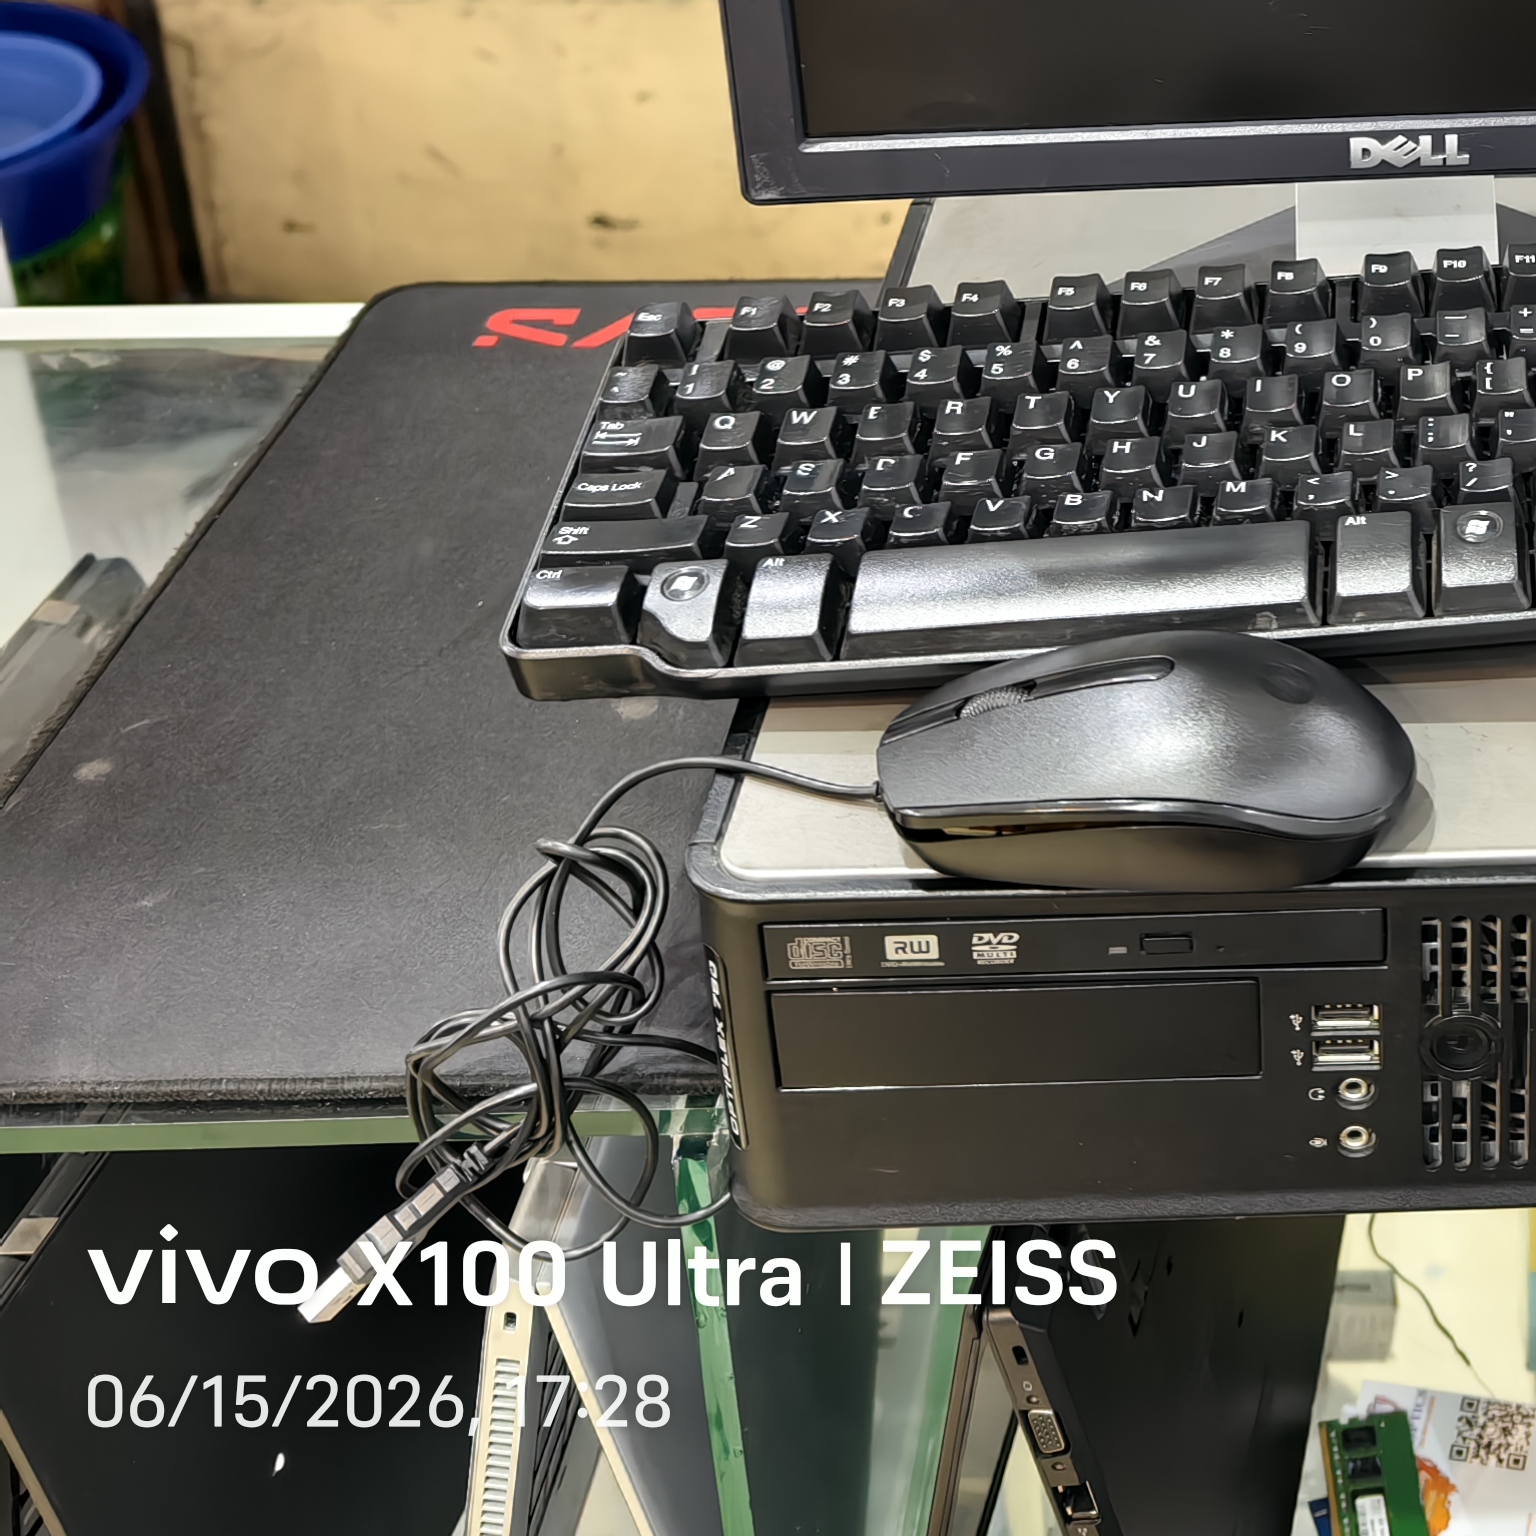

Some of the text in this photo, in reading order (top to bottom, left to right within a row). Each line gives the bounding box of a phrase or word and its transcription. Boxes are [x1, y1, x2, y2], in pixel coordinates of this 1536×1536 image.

[1348, 135, 1469, 167] DELL
[1442, 259, 1467, 269] F10
[1514, 254, 1536, 264] F11
[1371, 264, 1388, 274] F9
[1204, 276, 1223, 286] F7
[1276, 271, 1295, 281] F8
[1057, 287, 1075, 296] F5
[1130, 282, 1148, 292] F6
[888, 298, 906, 308] F3
[961, 293, 979, 303] F4
[740, 306, 758, 316] F1
[813, 302, 832, 313] F2
[636, 312, 663, 322] Esc
[1218, 347, 1232, 359] 8
[1294, 342, 1307, 354] 9
[1066, 358, 1080, 370] 6
[1143, 353, 1157, 365] 7
[913, 368, 928, 380] 4
[990, 363, 1004, 375] 5
[1407, 368, 1424, 381] P
[759, 378, 776, 390] 2
[836, 373, 851, 386] 3
[1103, 390, 1121, 404] Y
[1177, 384, 1196, 398] U
[945, 400, 964, 415] R
[1024, 395, 1043, 410] T
[791, 410, 818, 425] W
[868, 406, 882, 420] E
[600, 421, 625, 430] Tab
[713, 415, 736, 430] Q
[1270, 429, 1288, 443] K
[1349, 423, 1364, 437] L
[1112, 441, 1132, 454] H
[1192, 435, 1207, 448] J
[954, 452, 974, 466] F
[1034, 447, 1055, 461] G
[576, 481, 643, 494] Caps Lock
[1225, 481, 1247, 493] M
[1064, 493, 1083, 506] B
[1142, 489, 1164, 502] N
[985, 499, 1005, 512] V
[739, 515, 762, 529] Z
[820, 510, 843, 524] X
[1344, 515, 1367, 526] Alt
[558, 526, 590, 535] Shift
[763, 558, 784, 566] Alt
[535, 569, 563, 580] Ctrl
[972, 933, 1020, 944] DVD
[893, 940, 930, 955] RW
[715, 1017, 740, 1136] OPTIPLEX
